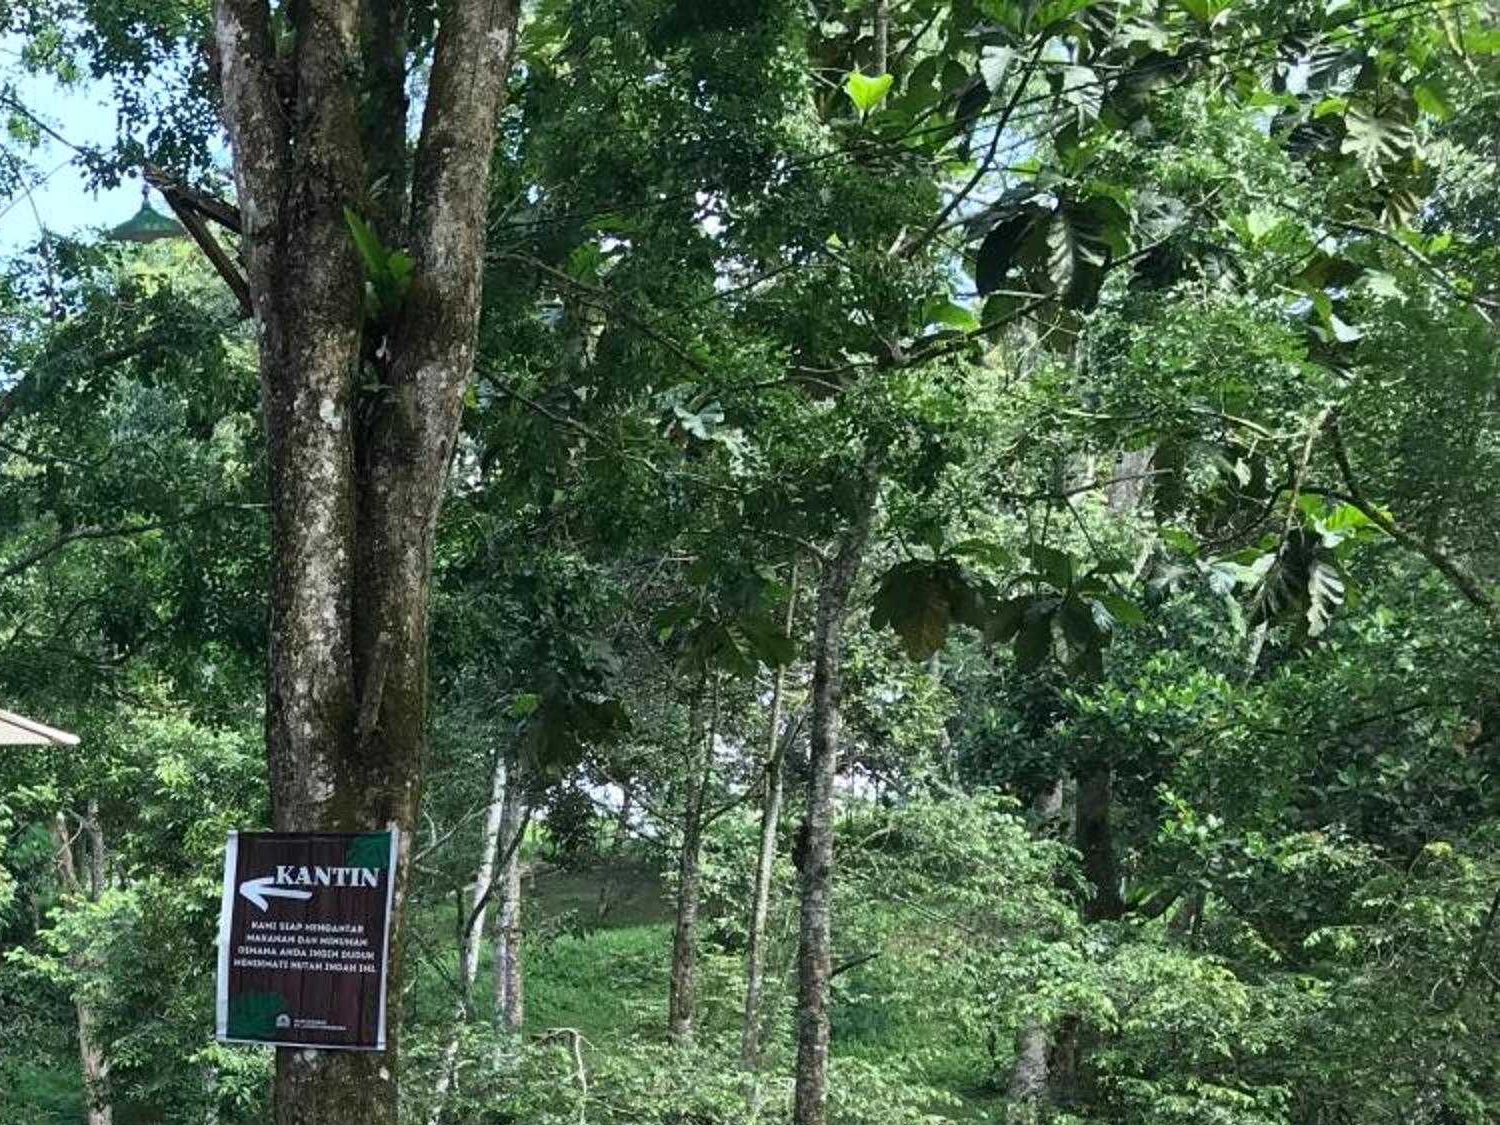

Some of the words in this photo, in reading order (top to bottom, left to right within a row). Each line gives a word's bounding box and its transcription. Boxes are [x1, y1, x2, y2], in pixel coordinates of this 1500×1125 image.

[276, 865, 380, 888] KANTIN
[251, 921, 277, 930] KAMI
[279, 921, 303, 931] SIAP
[305, 923, 364, 933] MENGANTAR
[246, 934, 295, 943] MAKANAN
[297, 935, 318, 945] DAN
[320, 937, 368, 947] MINUMAN
[279, 947, 307, 957] ANDA
[309, 949, 339, 959] INGIN
[341, 950, 375, 960] DUDUK
[290, 961, 323, 971] HUTAN
[324, 963, 357, 972] INDAH
